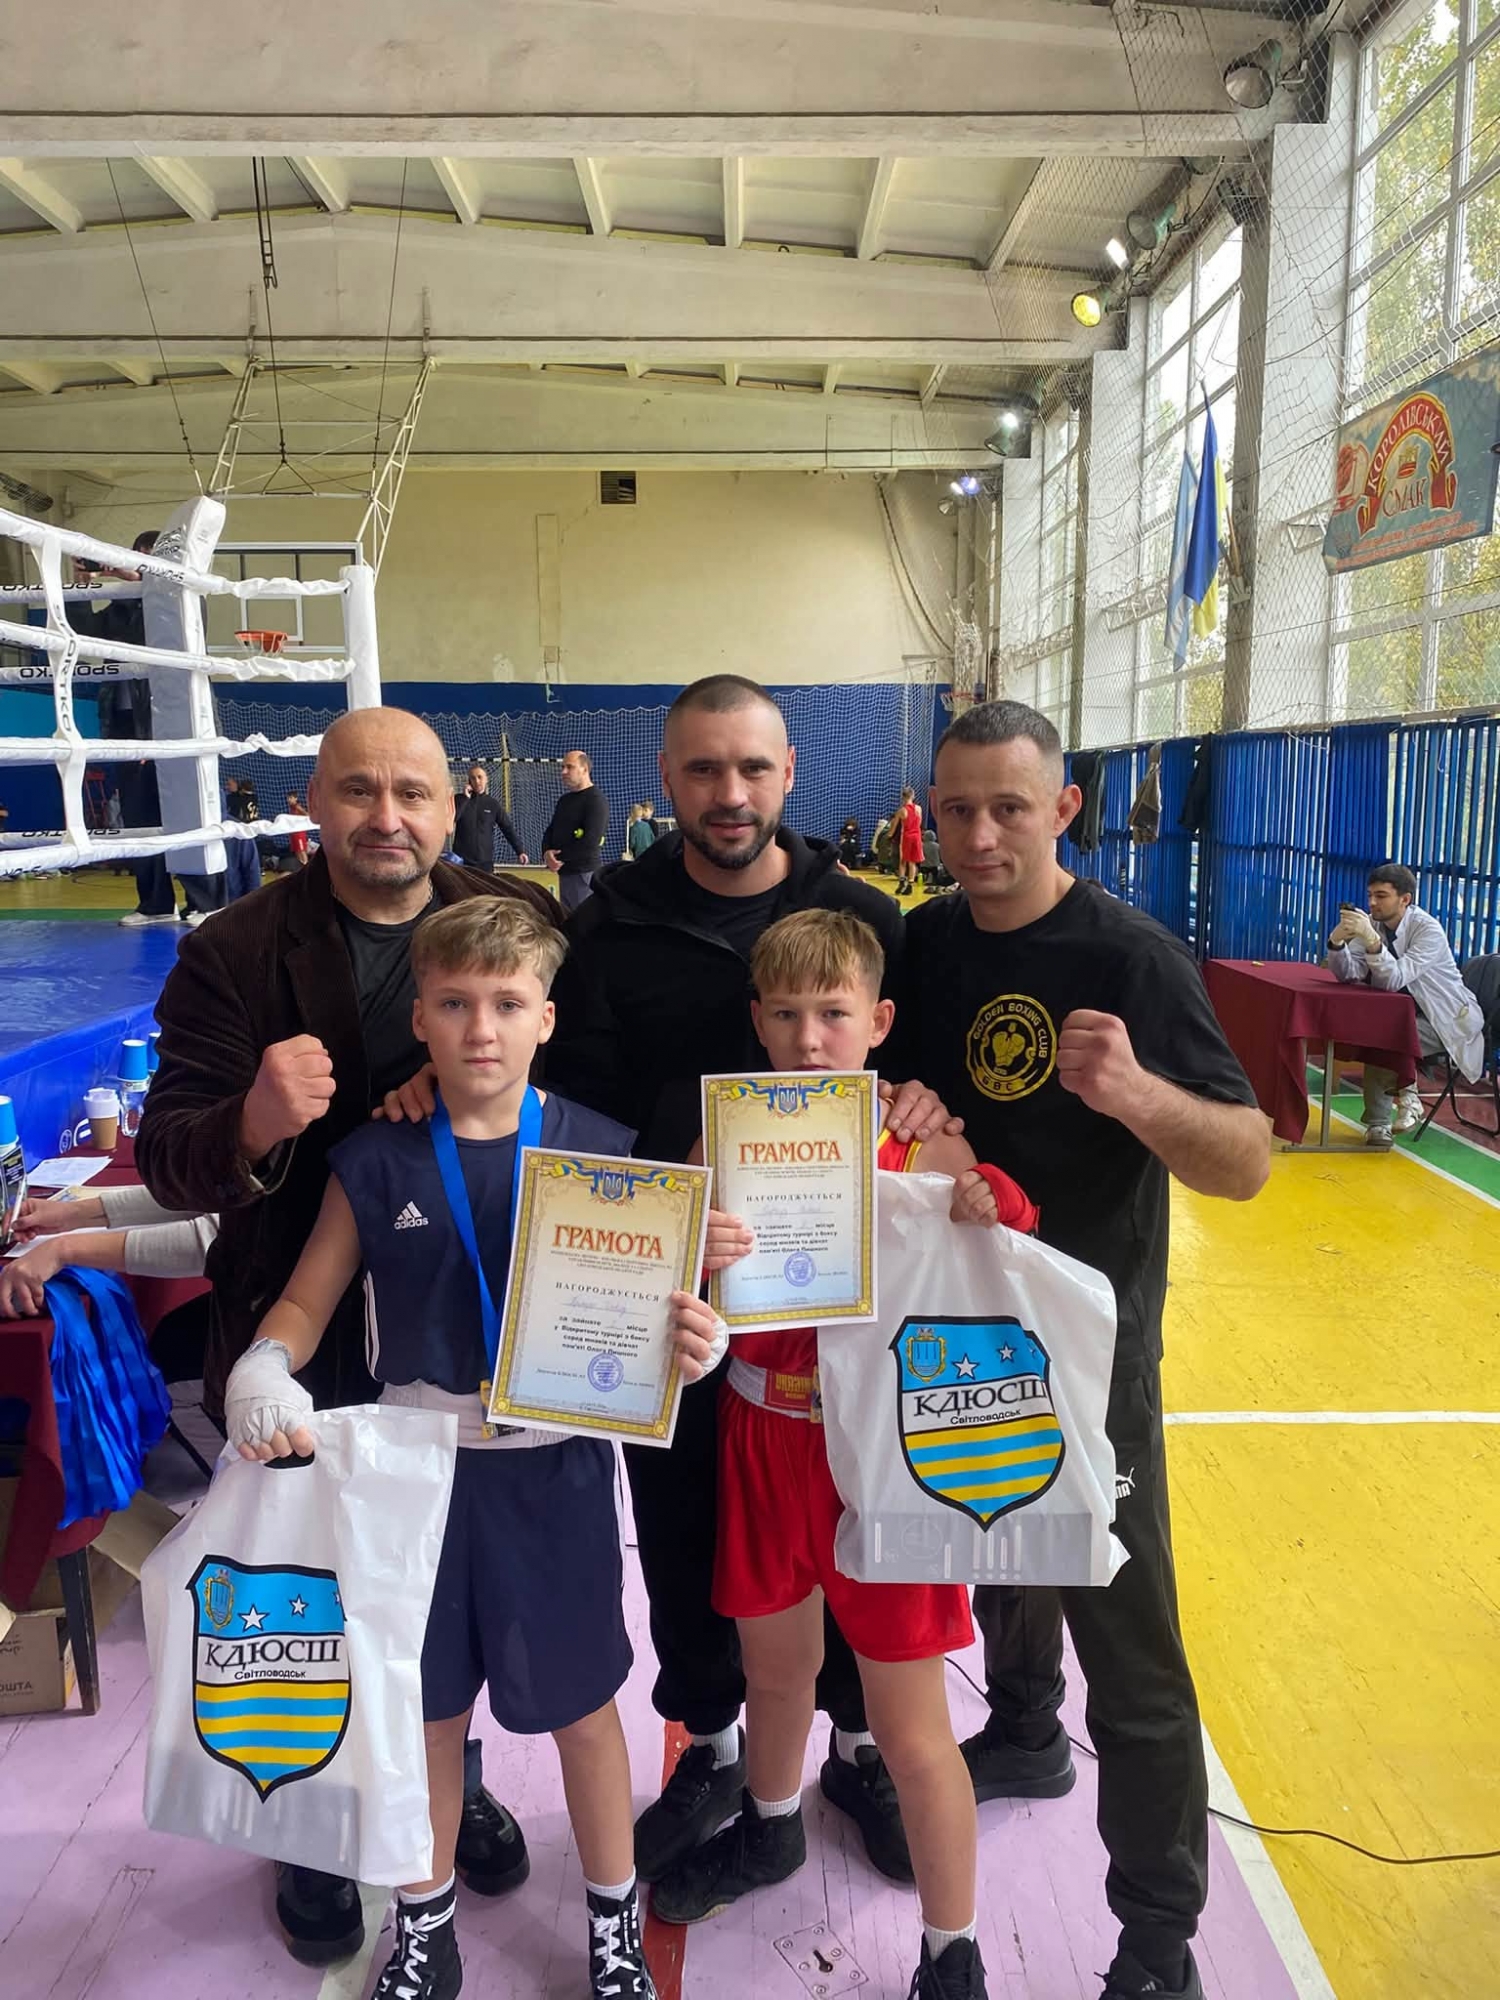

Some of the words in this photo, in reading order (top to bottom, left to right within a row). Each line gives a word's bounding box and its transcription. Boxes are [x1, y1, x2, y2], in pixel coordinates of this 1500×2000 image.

[1367, 403, 1451, 493] КОРОЛІВСЬКИЙ
[1383, 478, 1426, 517] СМАК
[3, 582, 103, 591] SPOTKO
[20, 664, 120, 678] SPOKO
[973, 1004, 1004, 1040] GOLDEN
[1008, 1003, 1042, 1026] BOXING
[1038, 1028, 1048, 1058] CLUB
[738, 1140, 843, 1164] ГРАМОТА
[394, 1217, 429, 1230] adidas
[552, 1223, 664, 1260] ГРАМОТА
[913, 1379, 1047, 1418] КДЮСШ
[950, 1409, 1021, 1425] Світловодськ
[204, 1639, 341, 1672] КДЮСШ
[234, 1669, 306, 1680] Світловодськ
